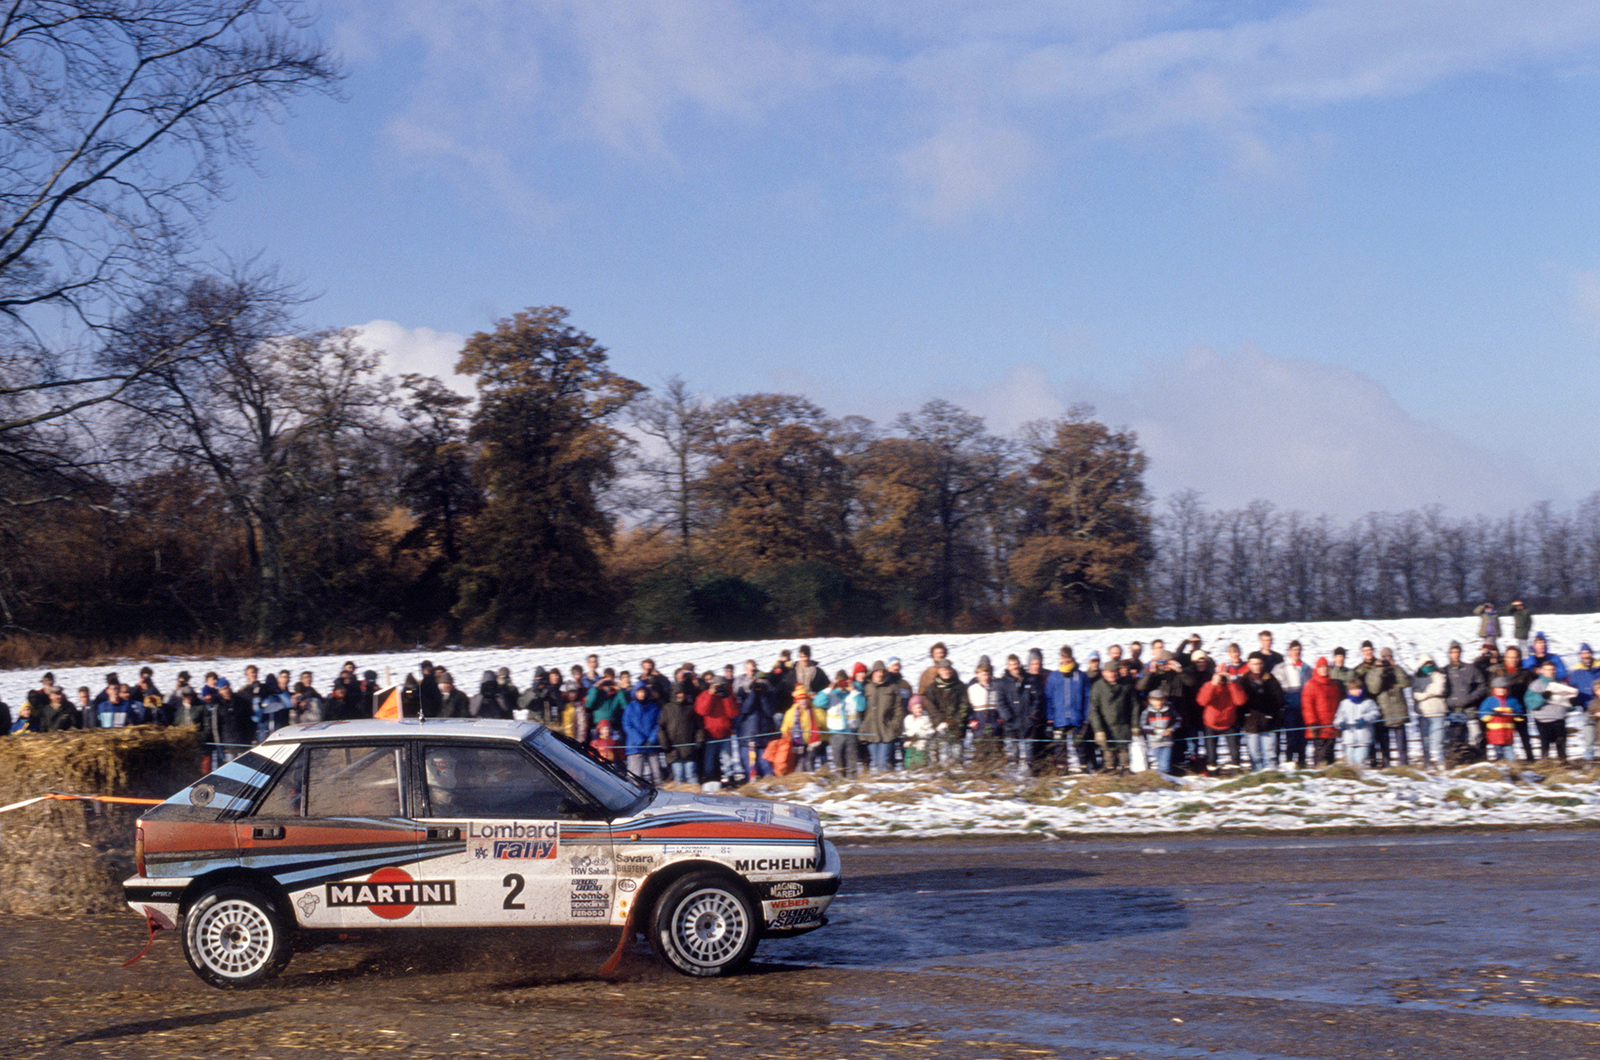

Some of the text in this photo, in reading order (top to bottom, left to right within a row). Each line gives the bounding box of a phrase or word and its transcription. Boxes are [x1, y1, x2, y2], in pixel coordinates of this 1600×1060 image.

[469, 821, 557, 838] Lombard
[497, 841, 554, 858] rally
[616, 853, 654, 863] Savara
[735, 858, 817, 870] MICHELIN
[570, 867, 610, 875] TRW Sabelt
[330, 884, 452, 904] MARTINI
[502, 873, 526, 910] 2
[571, 891, 610, 900] brembo
[770, 899, 810, 909] WEBER
[779, 908, 818, 919] OLIO
